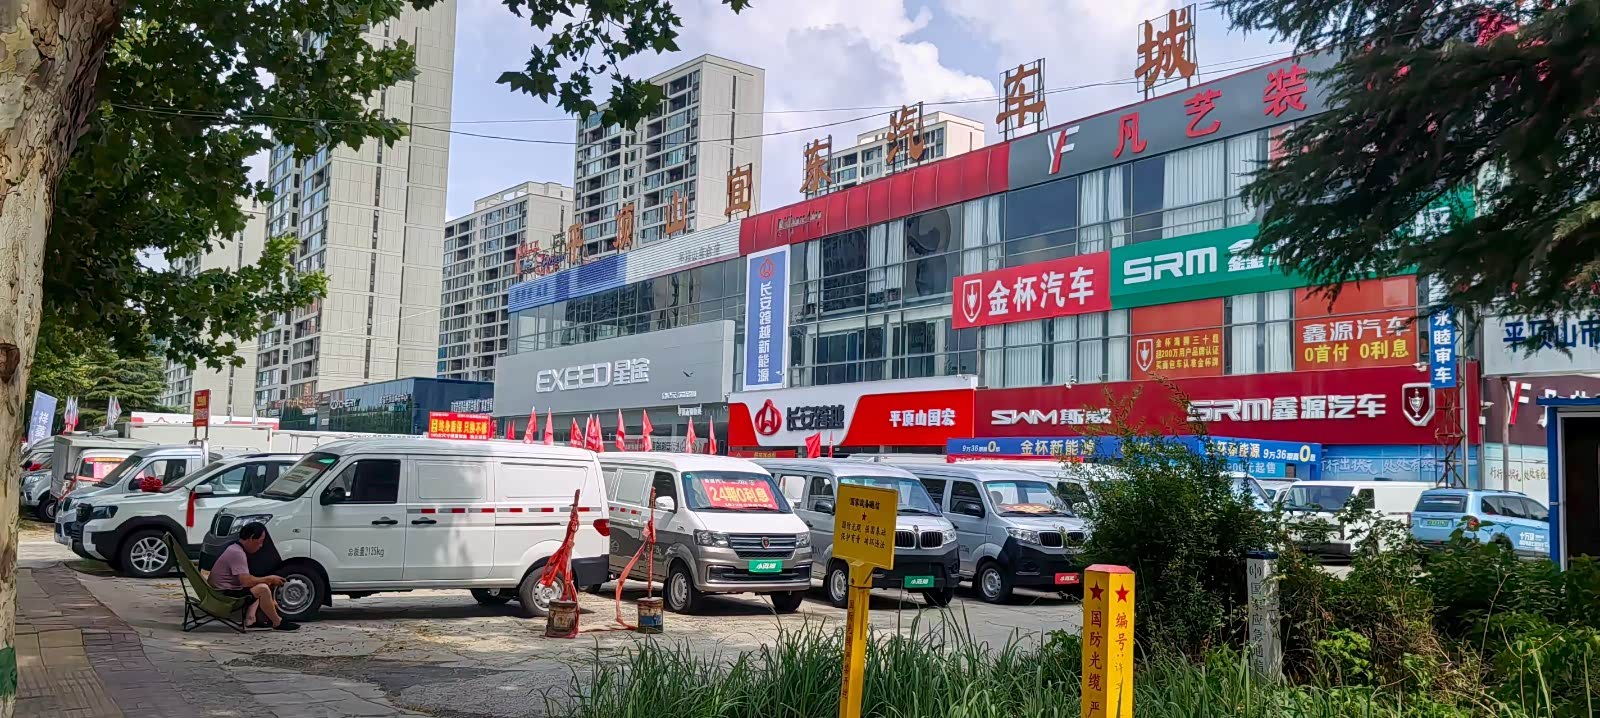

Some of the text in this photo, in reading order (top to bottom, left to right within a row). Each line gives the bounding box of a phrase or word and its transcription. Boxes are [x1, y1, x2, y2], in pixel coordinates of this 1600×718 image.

[1113, 64, 1309, 159] 凡艺装
[1123, 246, 1218, 285] SRM
[986, 265, 1095, 317] 金杯汽车
[757, 281, 773, 383] 长安跨越新能源
[1302, 316, 1411, 344] 鑫源汽车
[1304, 338, 1410, 364] 0首付 0利息
[1433, 310, 1453, 384] 永睦审车
[535, 357, 651, 393] EXEED 星途
[786, 403, 845, 432] 长安跨越
[888, 407, 957, 428] 平顶山国宏
[991, 409, 1058, 426] SWM
[1187, 393, 1387, 422] SRM鑫源汽车
[1490, 466, 1522, 482] 行行状元
[709, 486, 770, 503] 24期0利息
